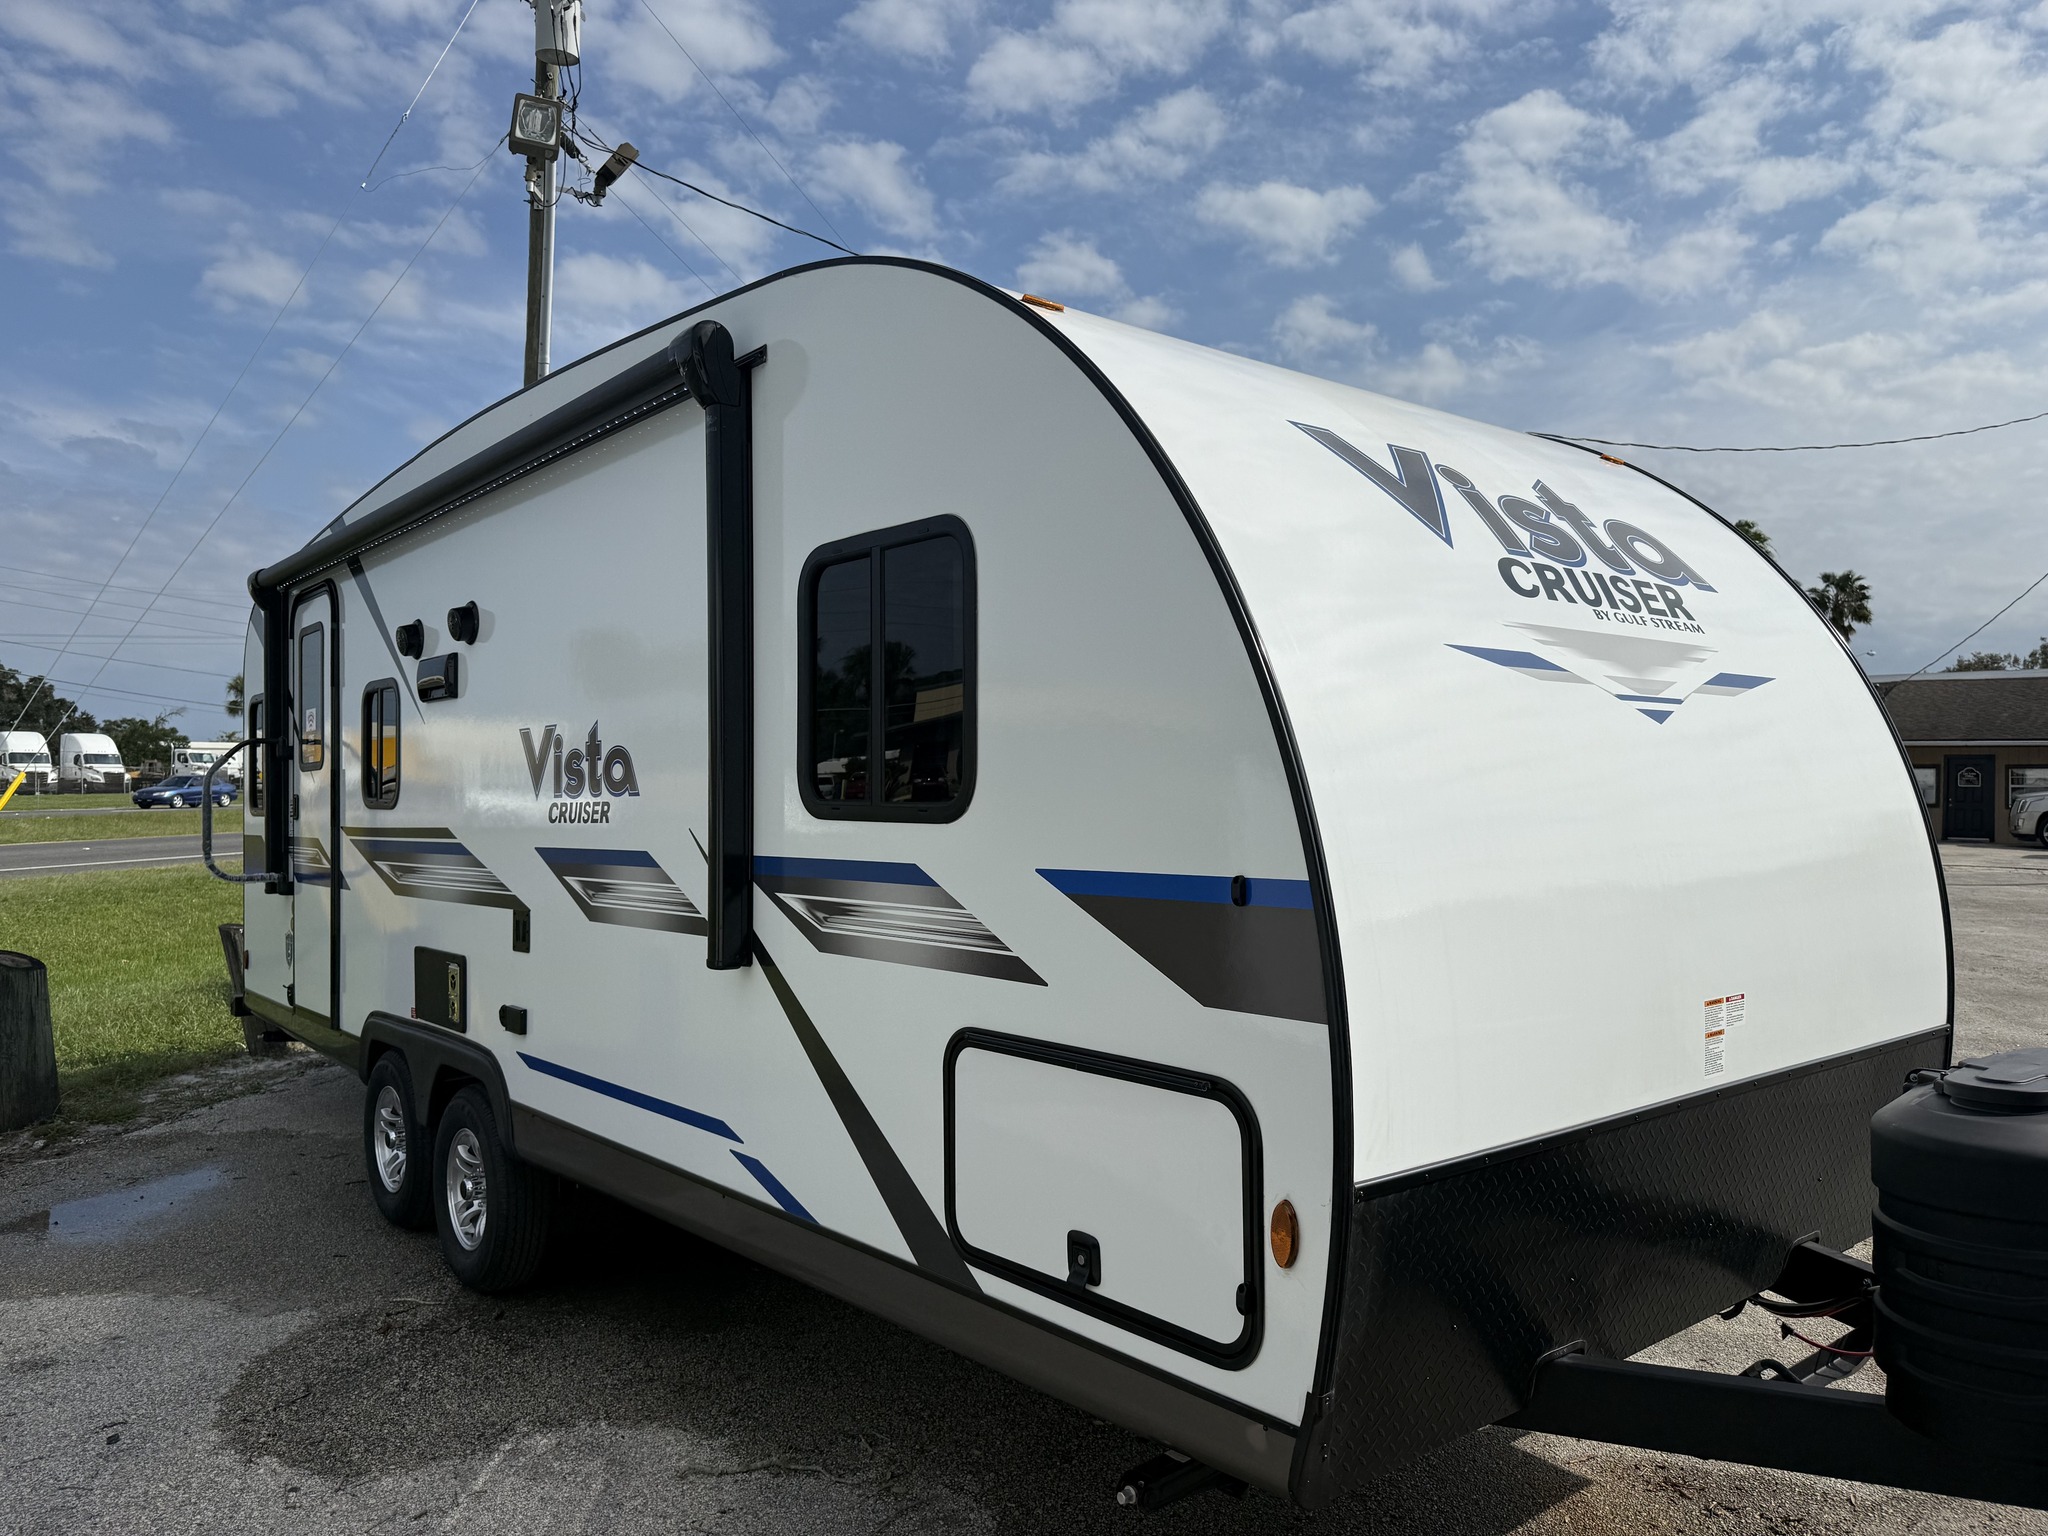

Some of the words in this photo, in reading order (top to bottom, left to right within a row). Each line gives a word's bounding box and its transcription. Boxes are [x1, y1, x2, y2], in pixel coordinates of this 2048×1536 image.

[1286, 419, 1718, 594] Vista
[1497, 557, 1696, 621] CRUISER
[1593, 609, 1611, 621] BY
[1613, 612, 1647, 626] GULF
[1650, 617, 1705, 634] STREAM
[519, 720, 640, 801] Vista
[548, 802, 611, 823] CRUISER
